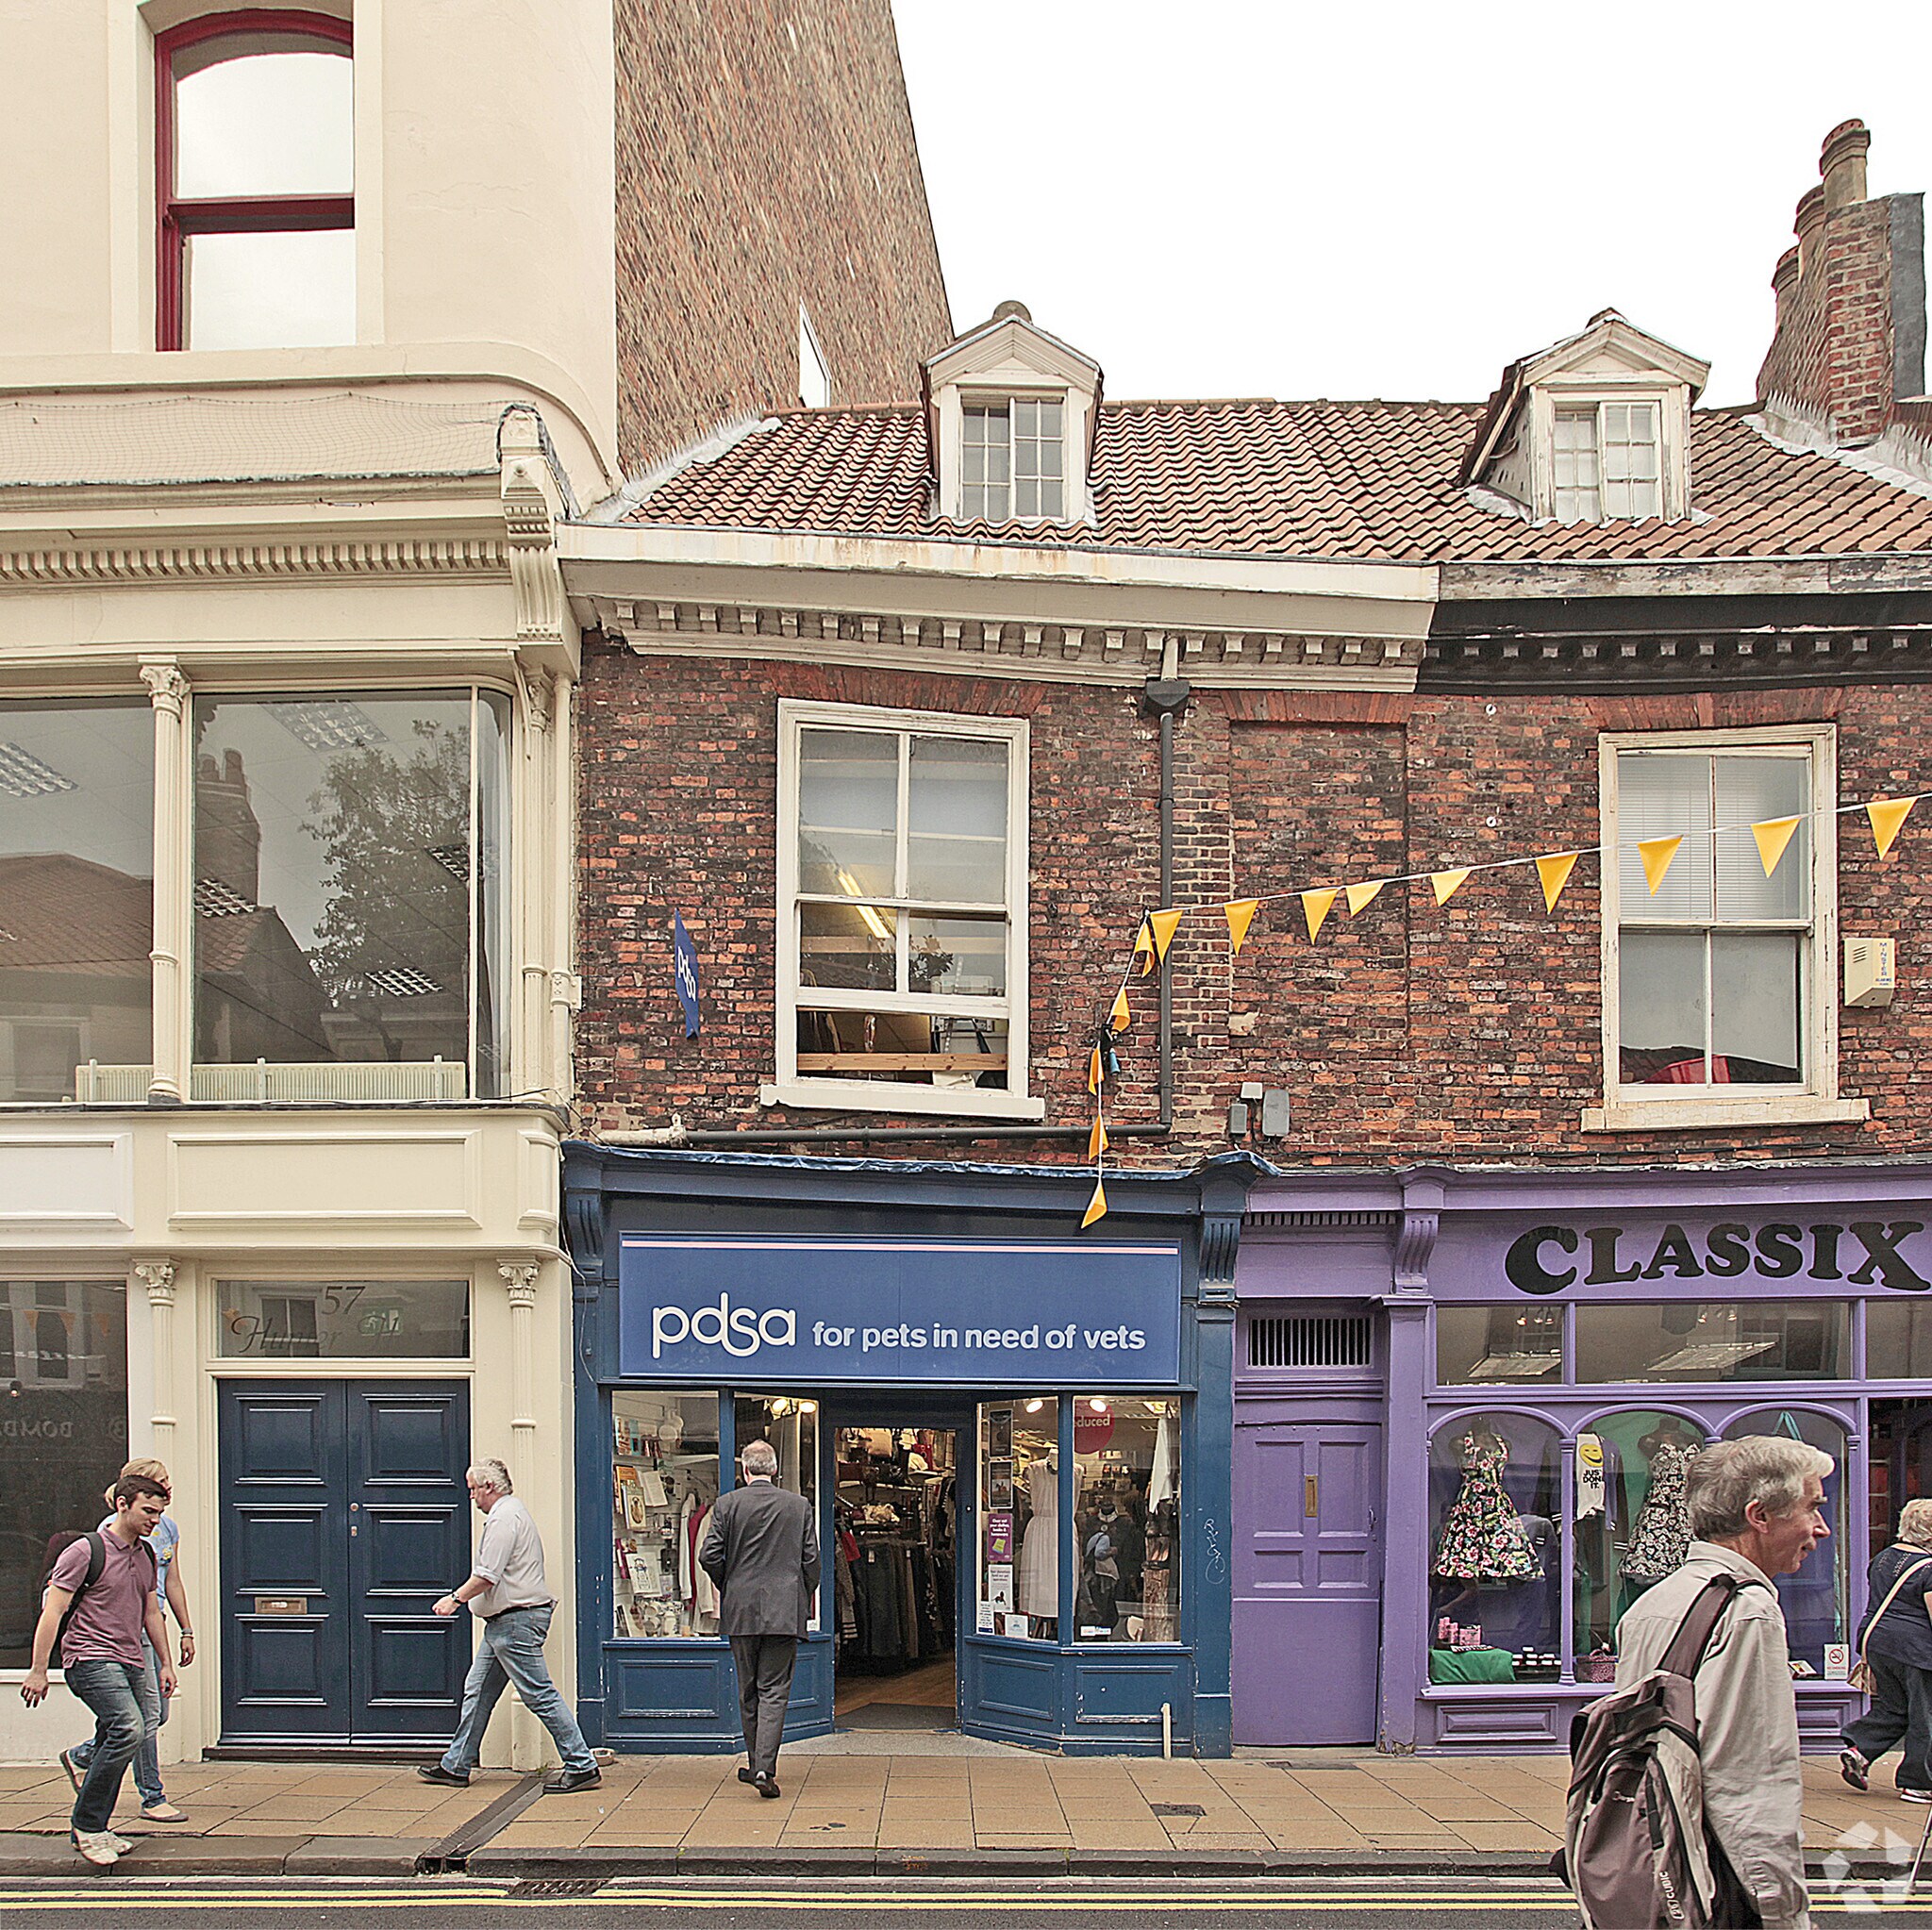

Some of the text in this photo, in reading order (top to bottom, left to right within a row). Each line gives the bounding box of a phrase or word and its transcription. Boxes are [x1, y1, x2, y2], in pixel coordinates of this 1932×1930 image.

[677, 946, 696, 1002] pdsa
[1505, 1222, 1932, 1295] CLASSIX
[321, 1286, 366, 1315] 57
[652, 1291, 1146, 1359] pdsa for pets in need of vets
[1074, 1414, 1110, 1426] duced
